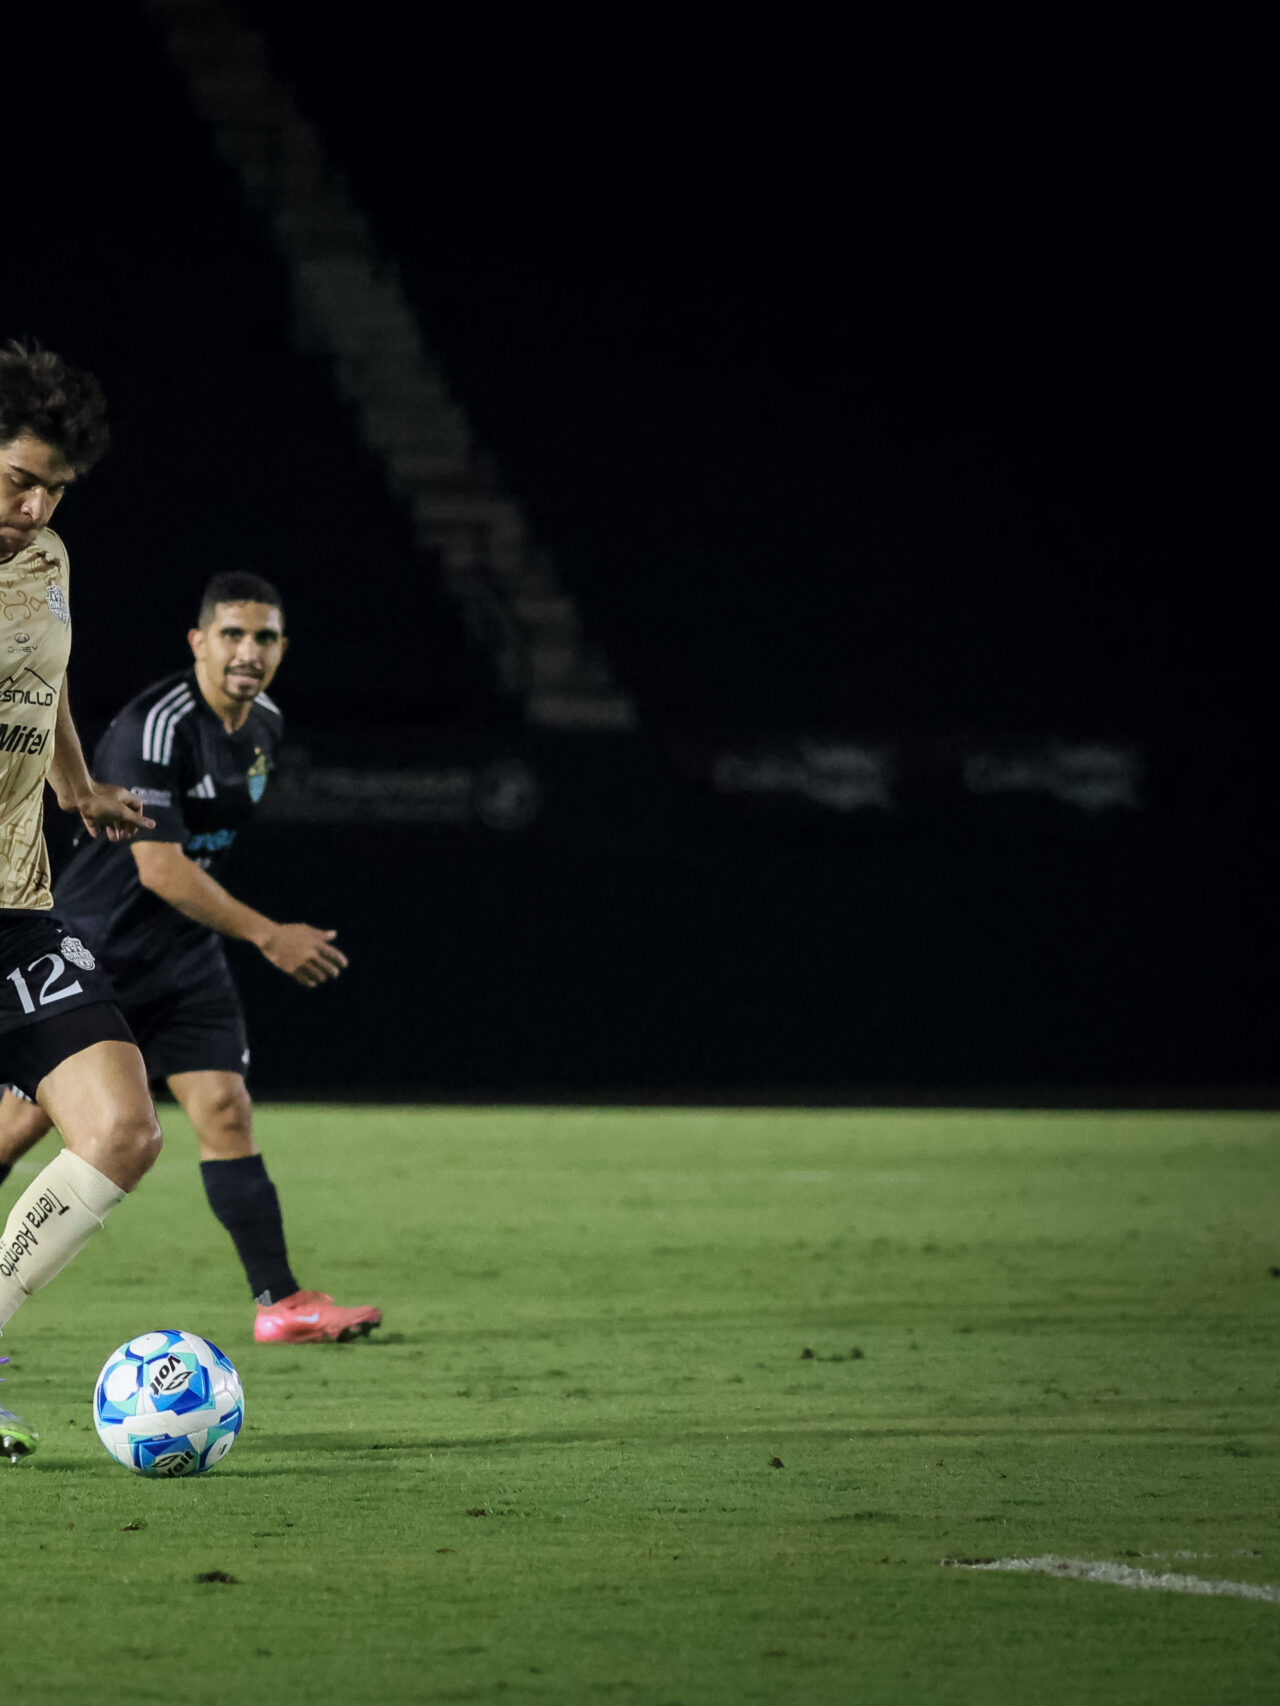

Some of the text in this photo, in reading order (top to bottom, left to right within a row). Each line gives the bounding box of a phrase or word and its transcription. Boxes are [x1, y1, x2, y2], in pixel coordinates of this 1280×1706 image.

[6, 953, 83, 1014] 12
[26, 1188, 70, 1229] Tierra
[149, 1354, 182, 1398] Voit
